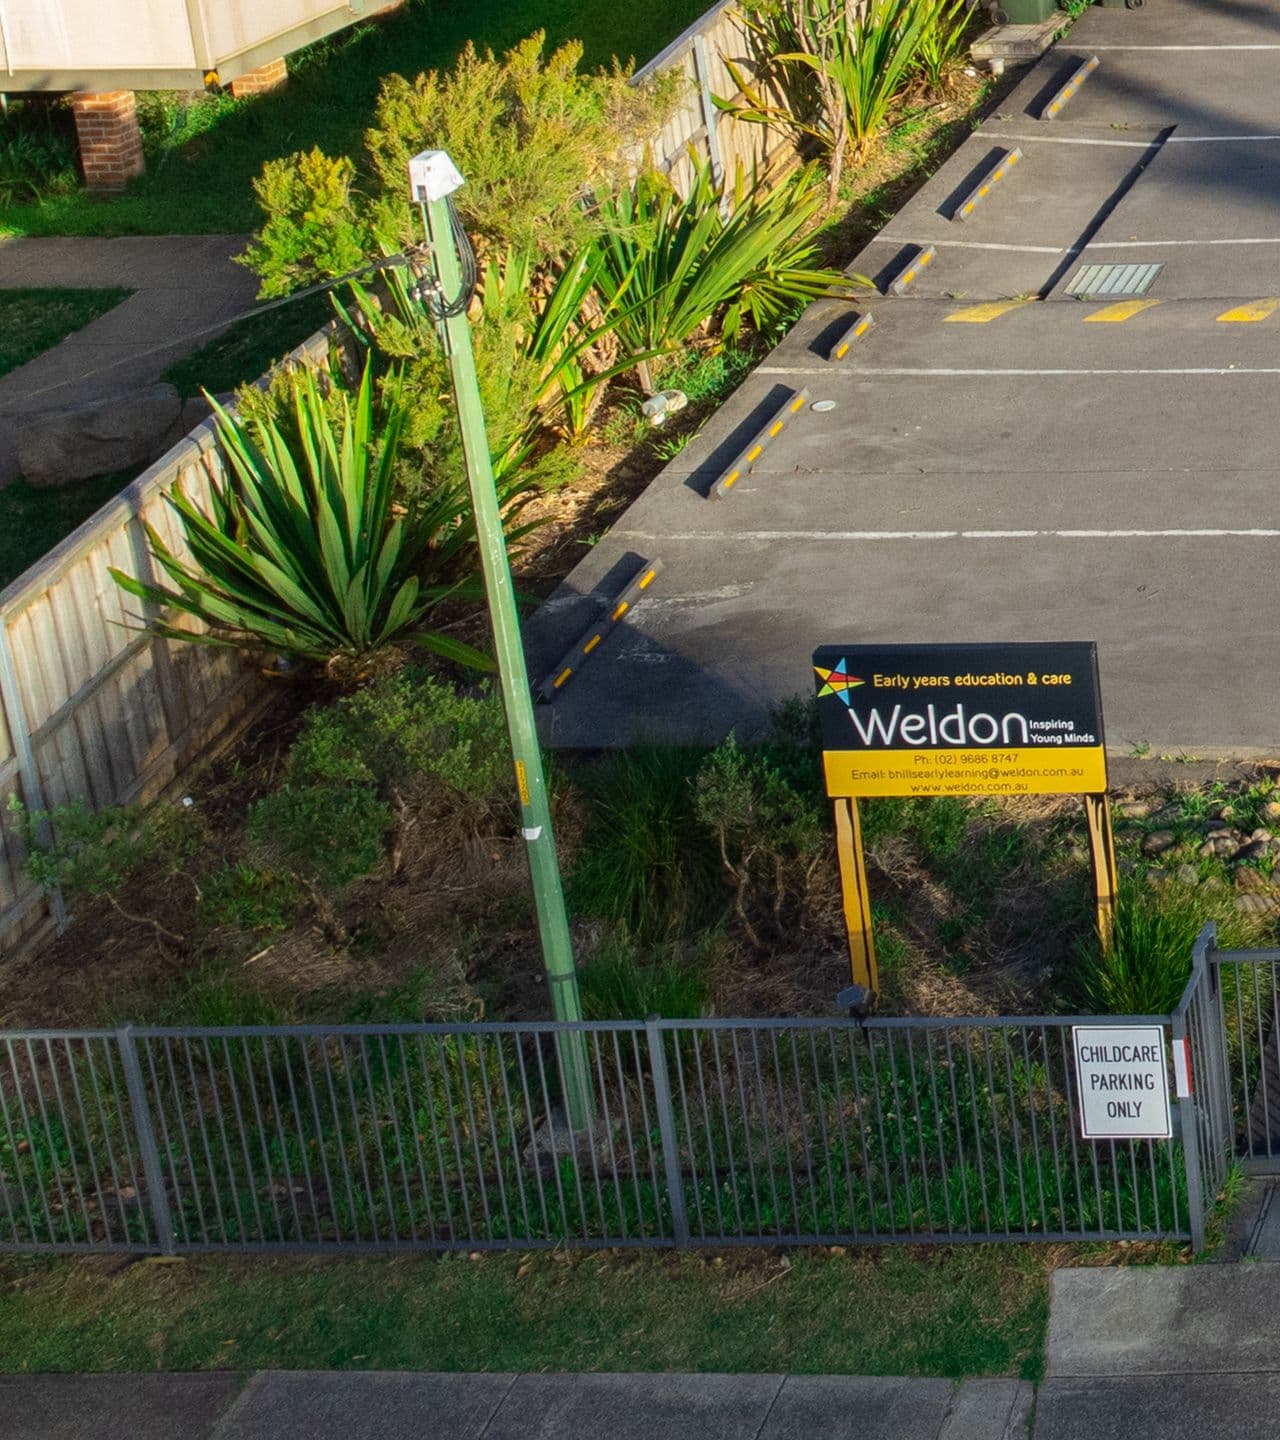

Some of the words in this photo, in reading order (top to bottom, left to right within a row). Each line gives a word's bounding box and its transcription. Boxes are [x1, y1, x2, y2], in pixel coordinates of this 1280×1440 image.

[873, 674, 910, 689] Early
[912, 674, 950, 689] years
[954, 672, 1023, 686] education
[1026, 672, 1038, 685] &
[1041, 672, 1072, 685] care
[848, 703, 1029, 746] Weldon
[1029, 719, 1074, 731] Inspiring
[1030, 733, 1062, 744] Young
[1064, 732, 1095, 743] Minds
[914, 755, 932, 765] Ph:
[935, 754, 957, 765] (02)
[960, 754, 988, 764] 9686
[991, 753, 1019, 763] 8747
[851, 770, 886, 780] Email:
[911, 782, 1028, 793] www.weldon.com.au
[1080, 1045, 1160, 1063] CHILDCARE
[1090, 1073, 1155, 1091] PARKING
[1107, 1101, 1142, 1118] ONLY
